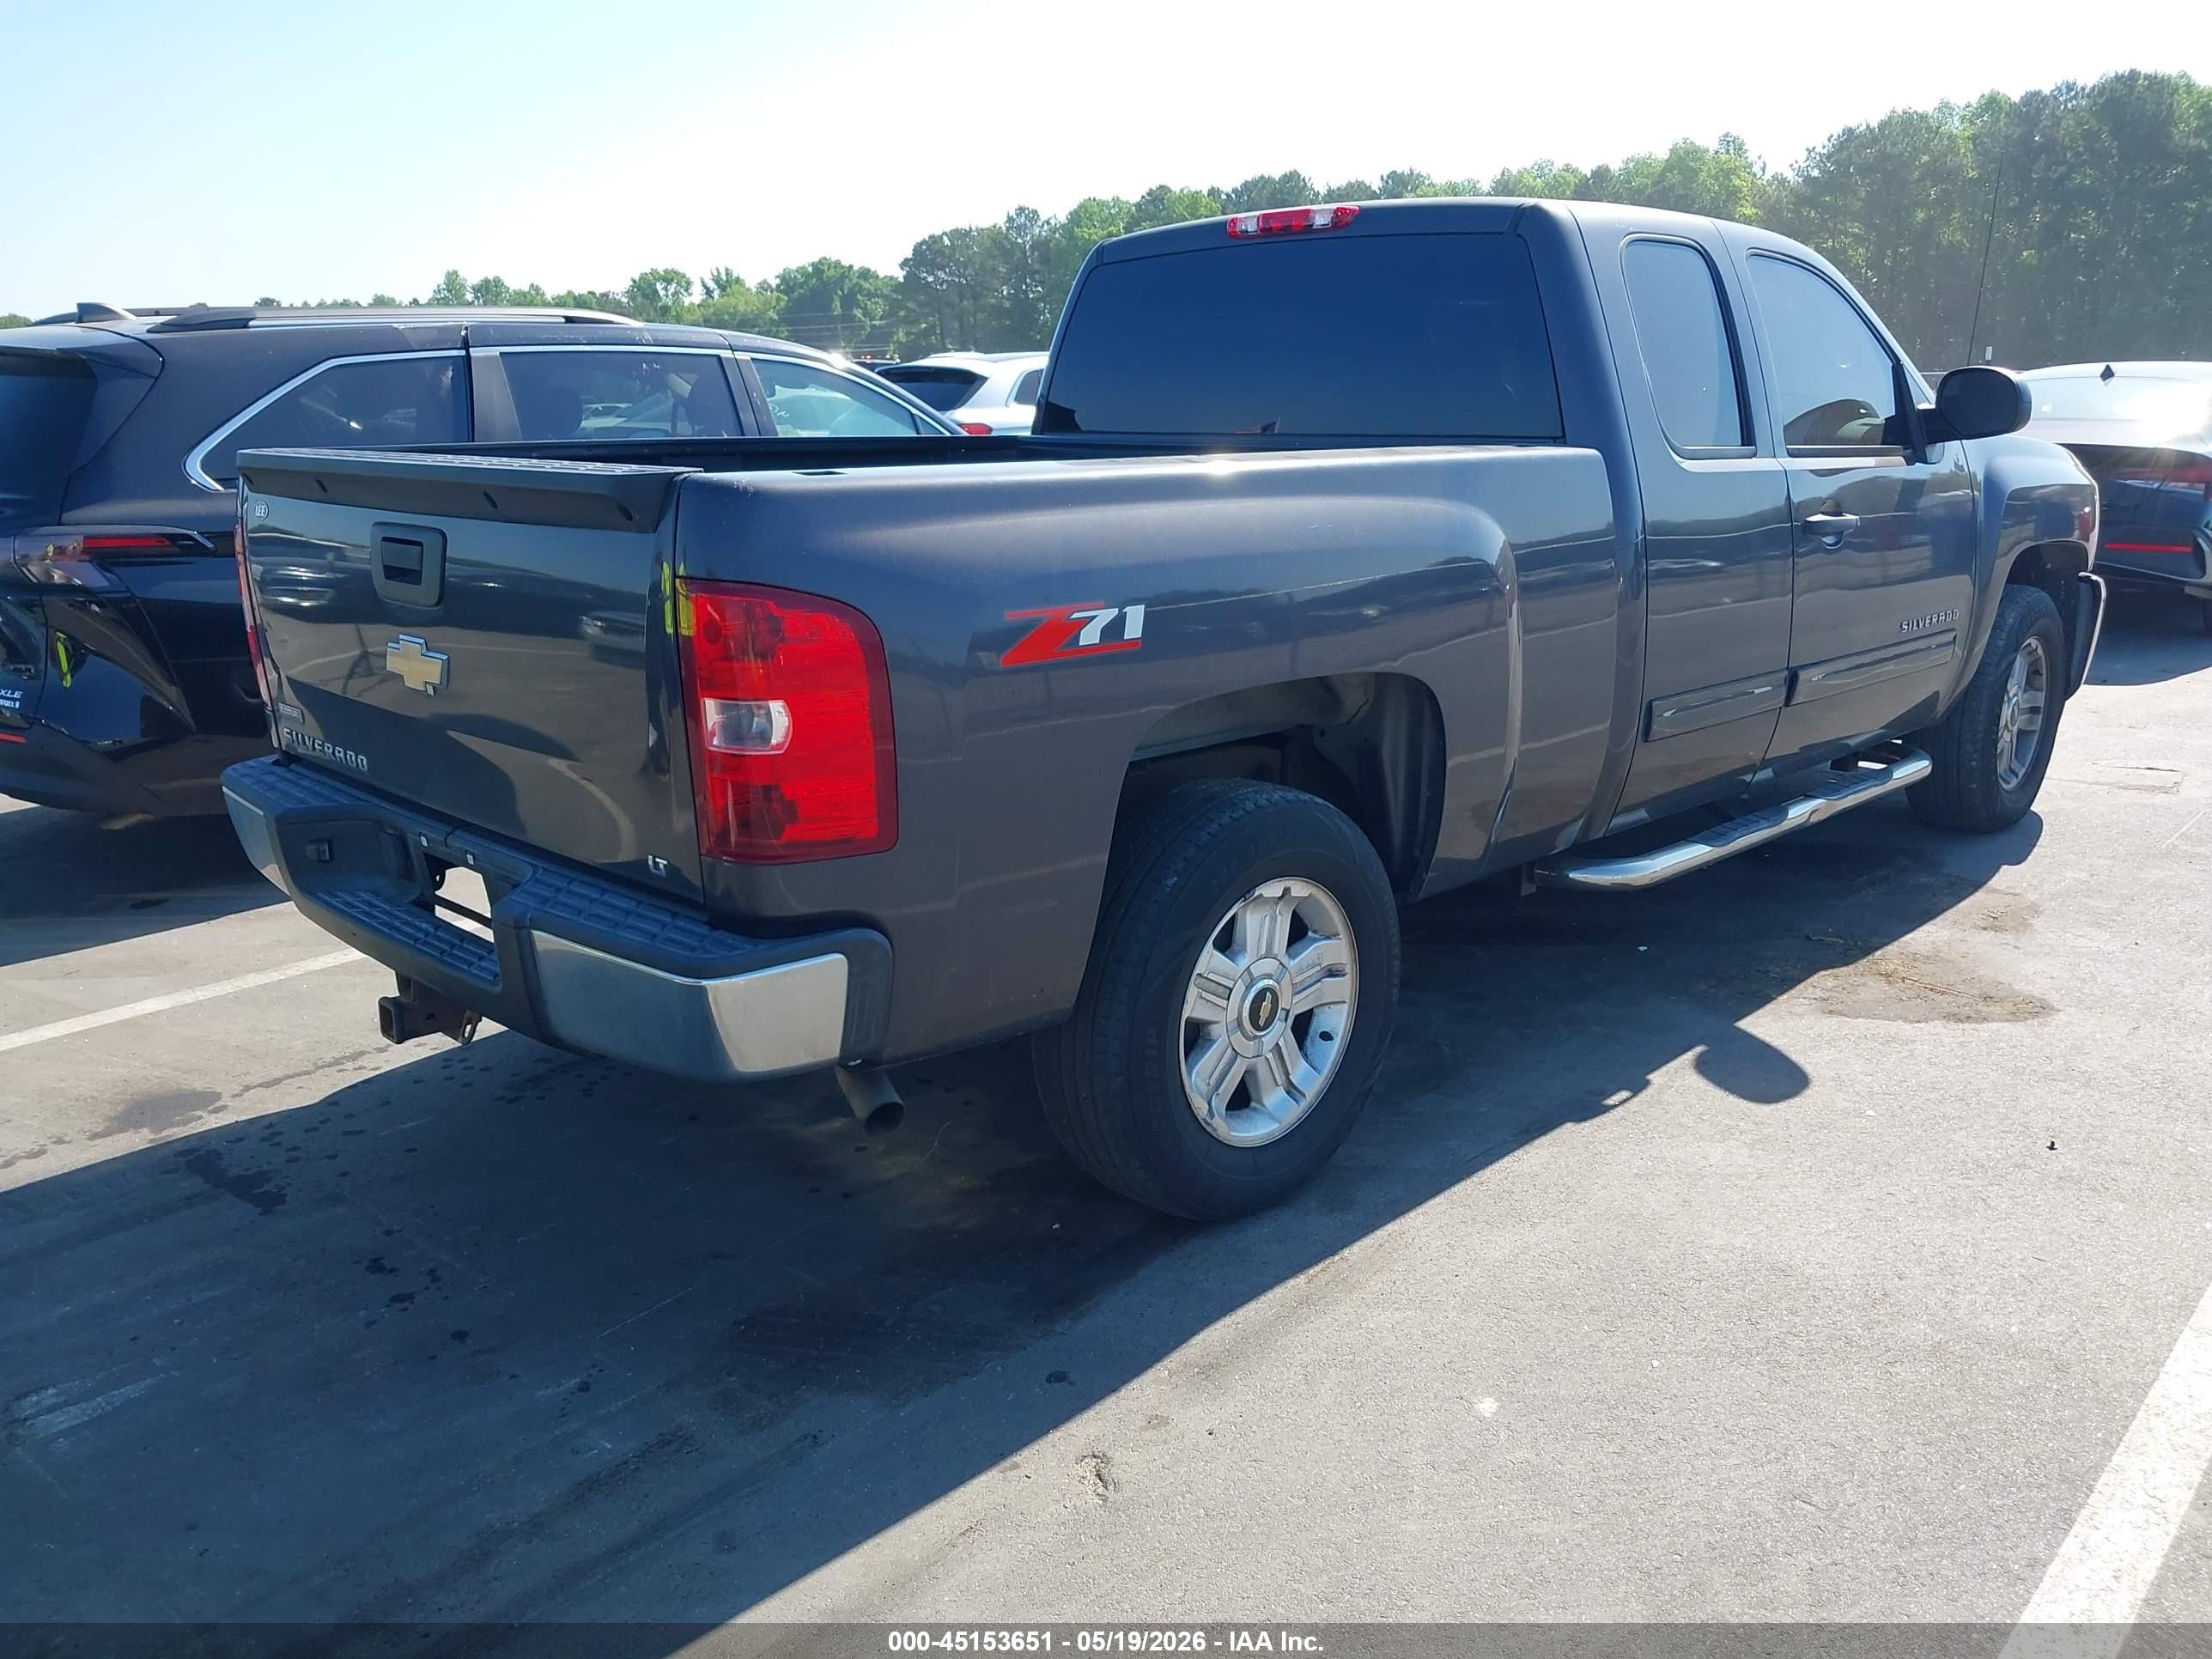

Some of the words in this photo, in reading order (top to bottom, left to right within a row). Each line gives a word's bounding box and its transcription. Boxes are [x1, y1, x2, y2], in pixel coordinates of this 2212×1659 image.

[1000, 600, 1146, 668] Z71
[1900, 609, 1960, 633] SILVERADO
[283, 727, 369, 772] SILVERADO
[647, 854, 668, 877] LT
